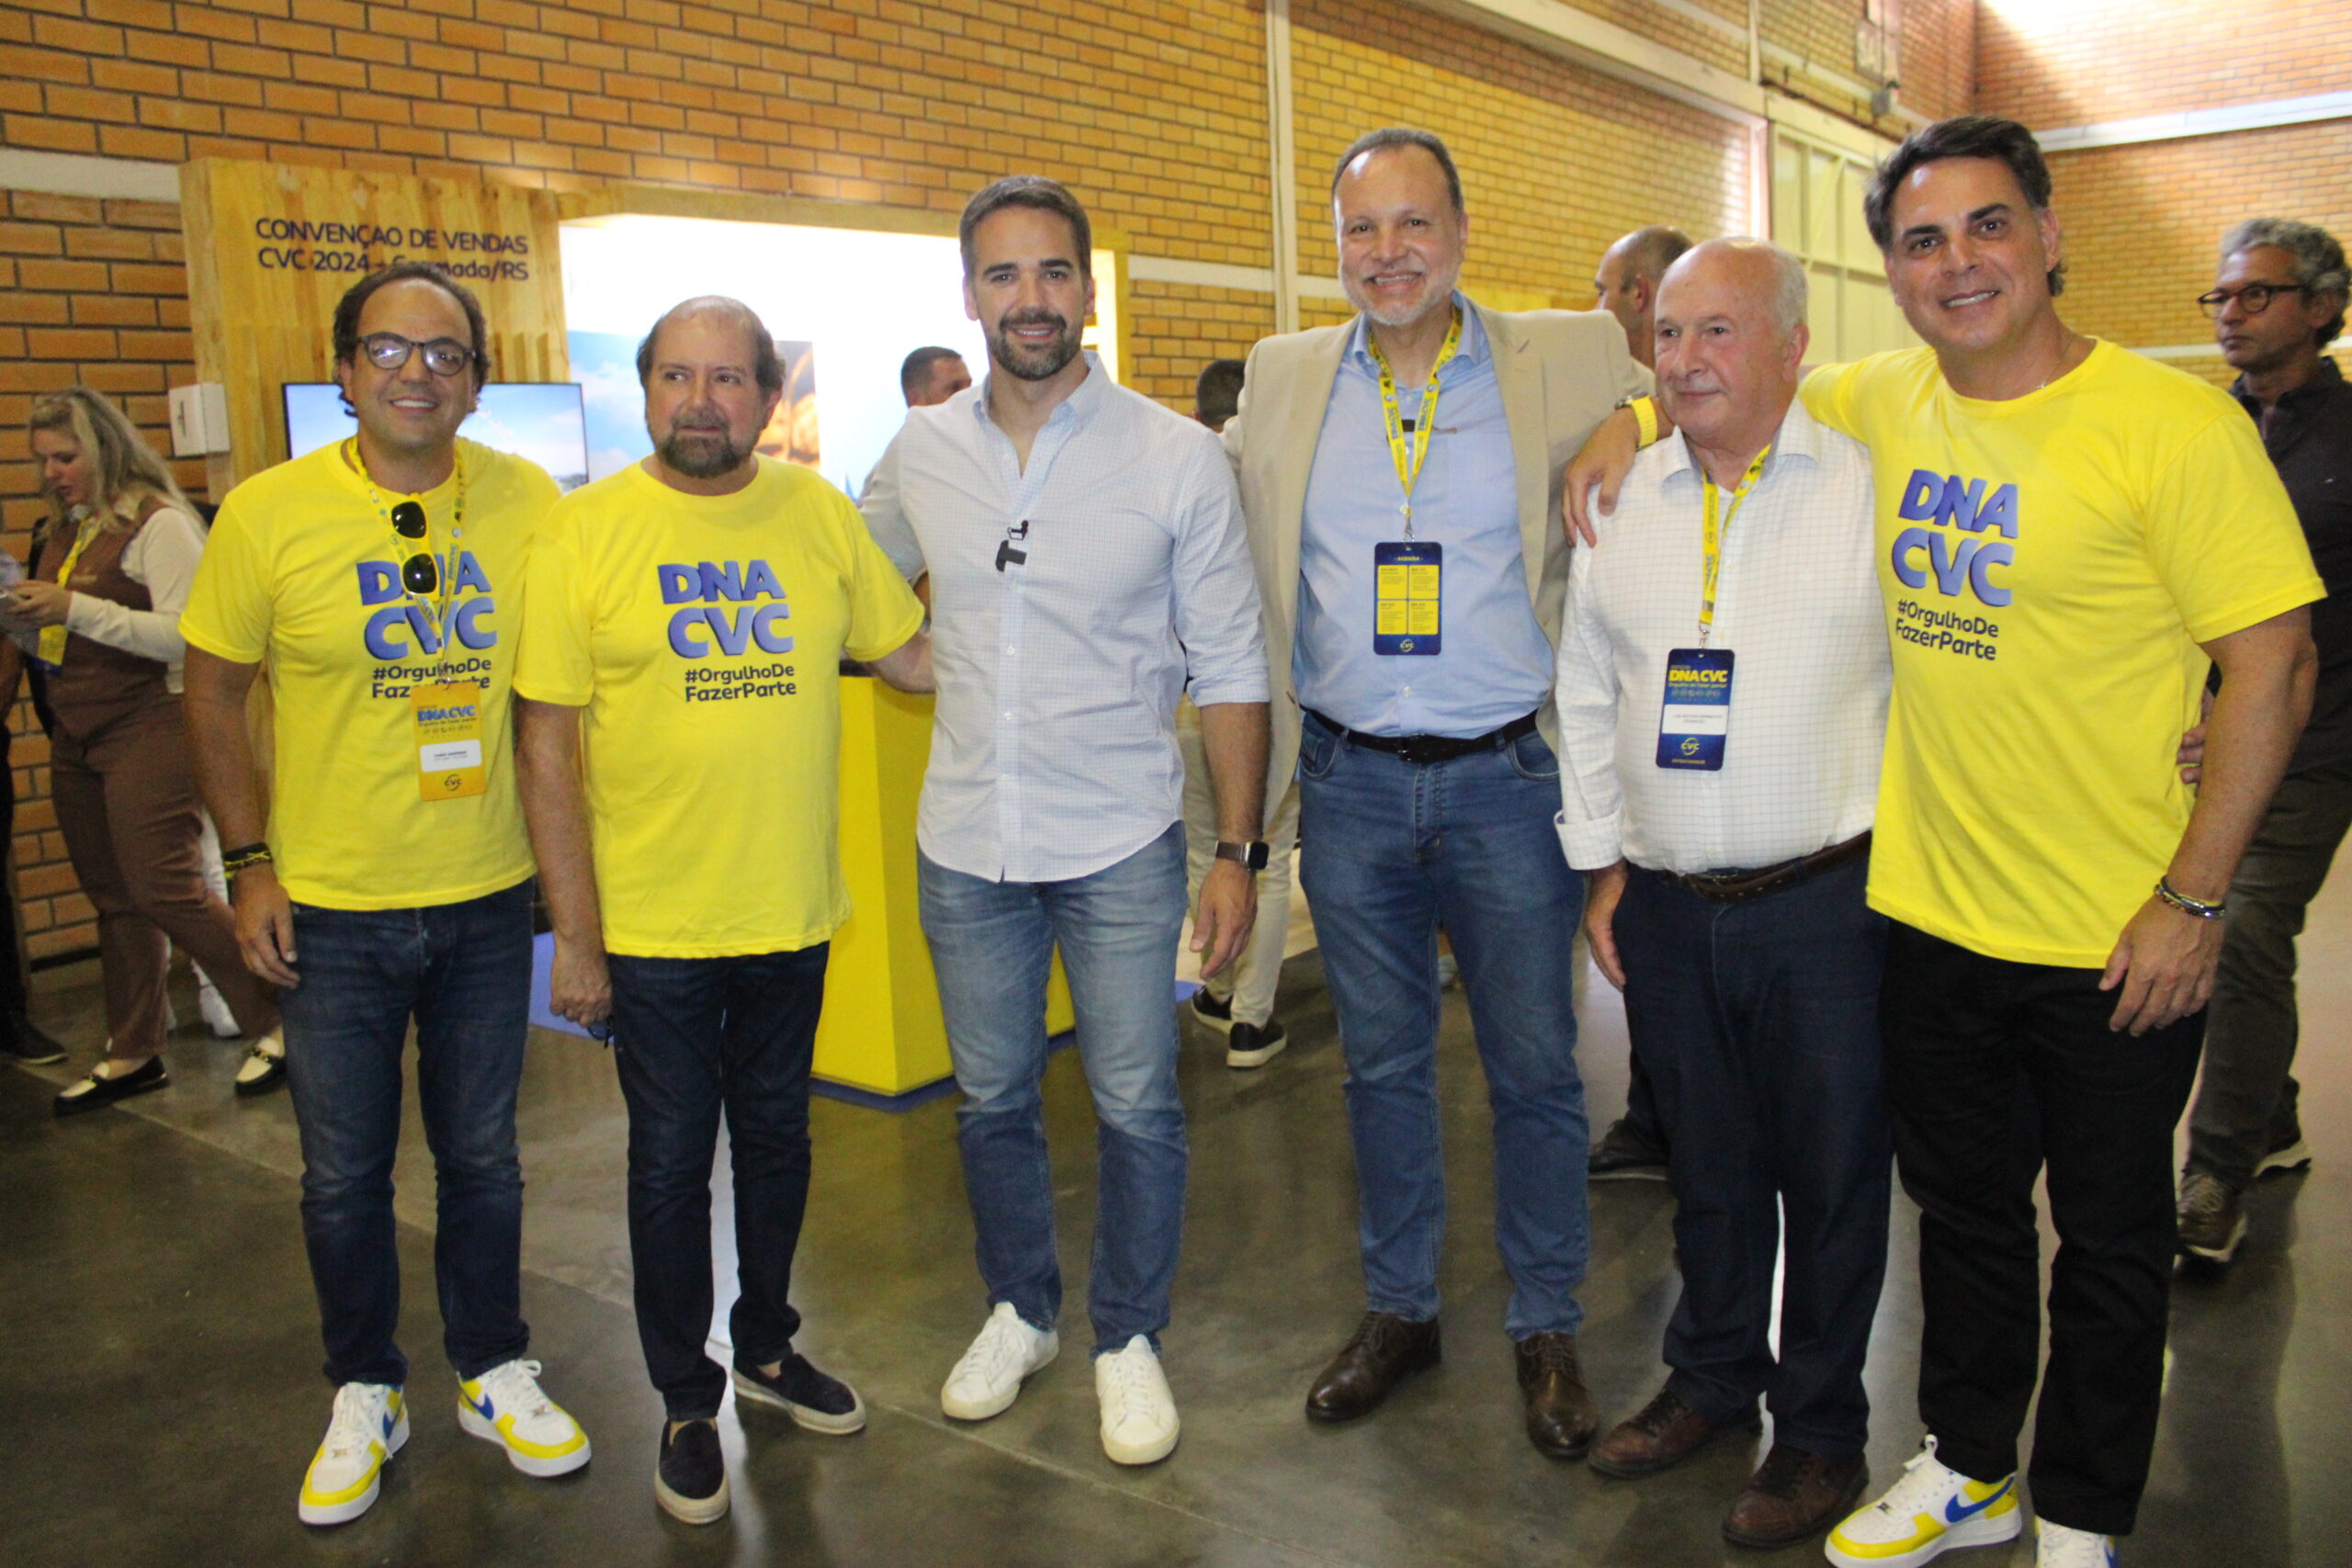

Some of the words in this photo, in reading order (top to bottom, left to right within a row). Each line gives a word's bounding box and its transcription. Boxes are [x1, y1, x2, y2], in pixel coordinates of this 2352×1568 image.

[258, 247, 307, 270] CVC
[312, 251, 369, 272] 2024
[410, 228, 437, 249] DE
[444, 231, 528, 254] VENDAS
[1898, 468, 2018, 539] DNA
[658, 559, 787, 604] DNA
[1892, 527, 2015, 607] CVC
[365, 596, 498, 661] CVC
[668, 603, 795, 660] CVC
[1897, 598, 1999, 637] #OrgulhoDe
[1896, 617, 1996, 660] FazerParte
[684, 663, 795, 685] #OrgulhoDe
[685, 681, 797, 703] FazerParte
[1680, 742, 1701, 750] CVC
